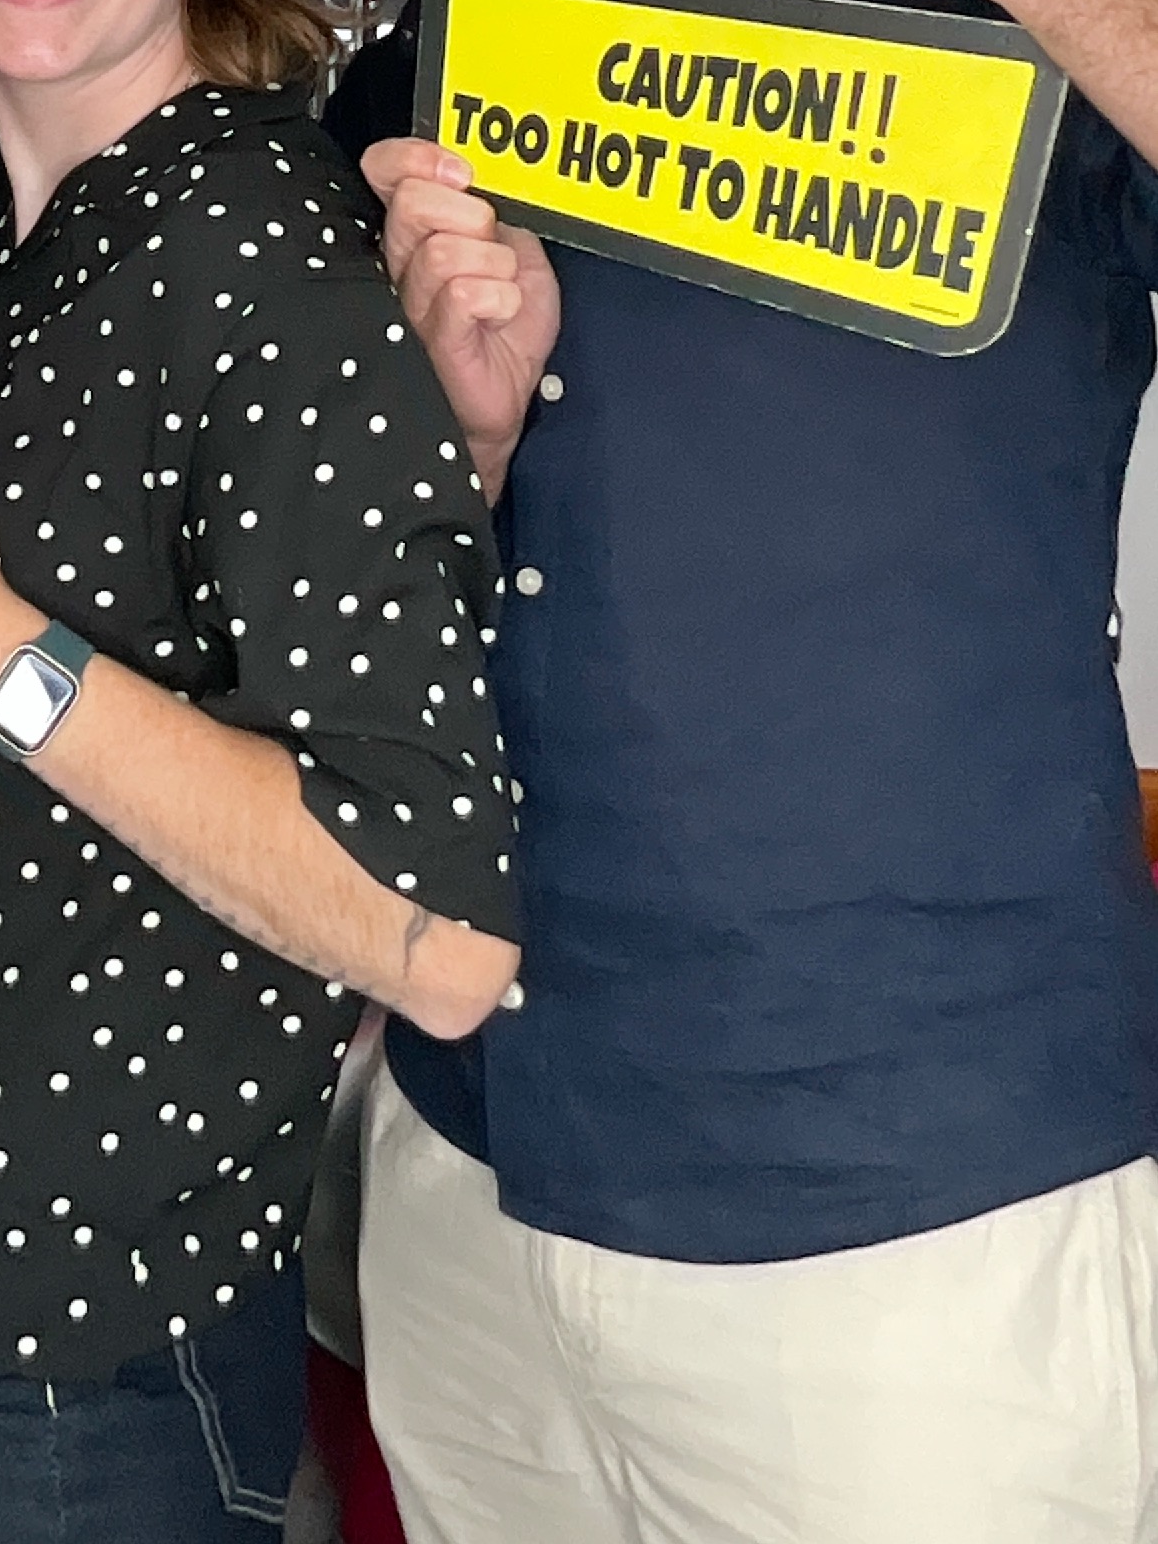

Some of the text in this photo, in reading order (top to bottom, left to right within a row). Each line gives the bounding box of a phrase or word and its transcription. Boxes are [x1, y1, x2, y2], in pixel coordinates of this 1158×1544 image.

[597, 42, 898, 164] CAUTION!!
[452, 93, 986, 294] TOO HOT TO HANDLE
